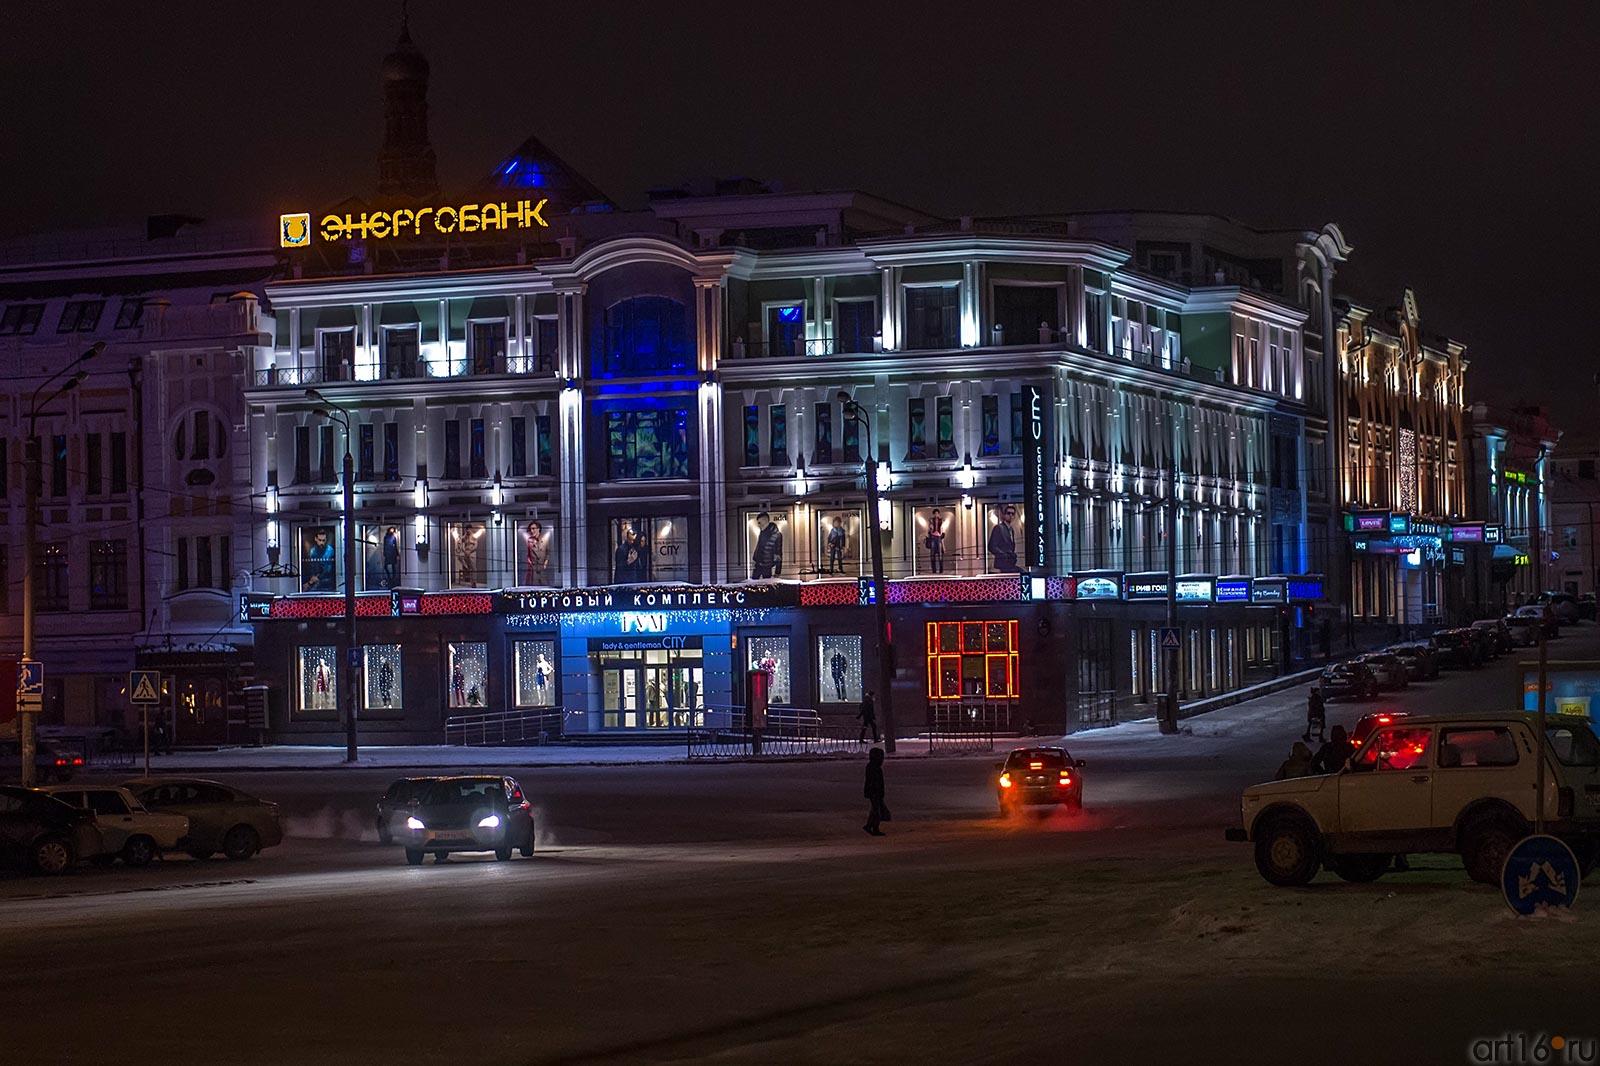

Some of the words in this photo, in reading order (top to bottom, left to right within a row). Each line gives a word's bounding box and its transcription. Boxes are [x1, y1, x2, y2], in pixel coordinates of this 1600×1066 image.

[320, 199, 549, 241] ЭНЕРГОБАНК
[1031, 387, 1041, 440] CITY
[660, 545, 680, 556] CITY
[519, 594, 613, 608] ТОРГОВЫЙ
[634, 592, 745, 606] КОМПЛЕКС
[859, 580, 868, 604] ГУМ
[1022, 576, 1030, 600] ГУМ
[391, 592, 399, 616] ГУМ
[622, 613, 665, 633] ГУМ
[602, 642, 617, 650] lady
[624, 641, 661, 650] gentleman
[662, 636, 686, 648] CITY
